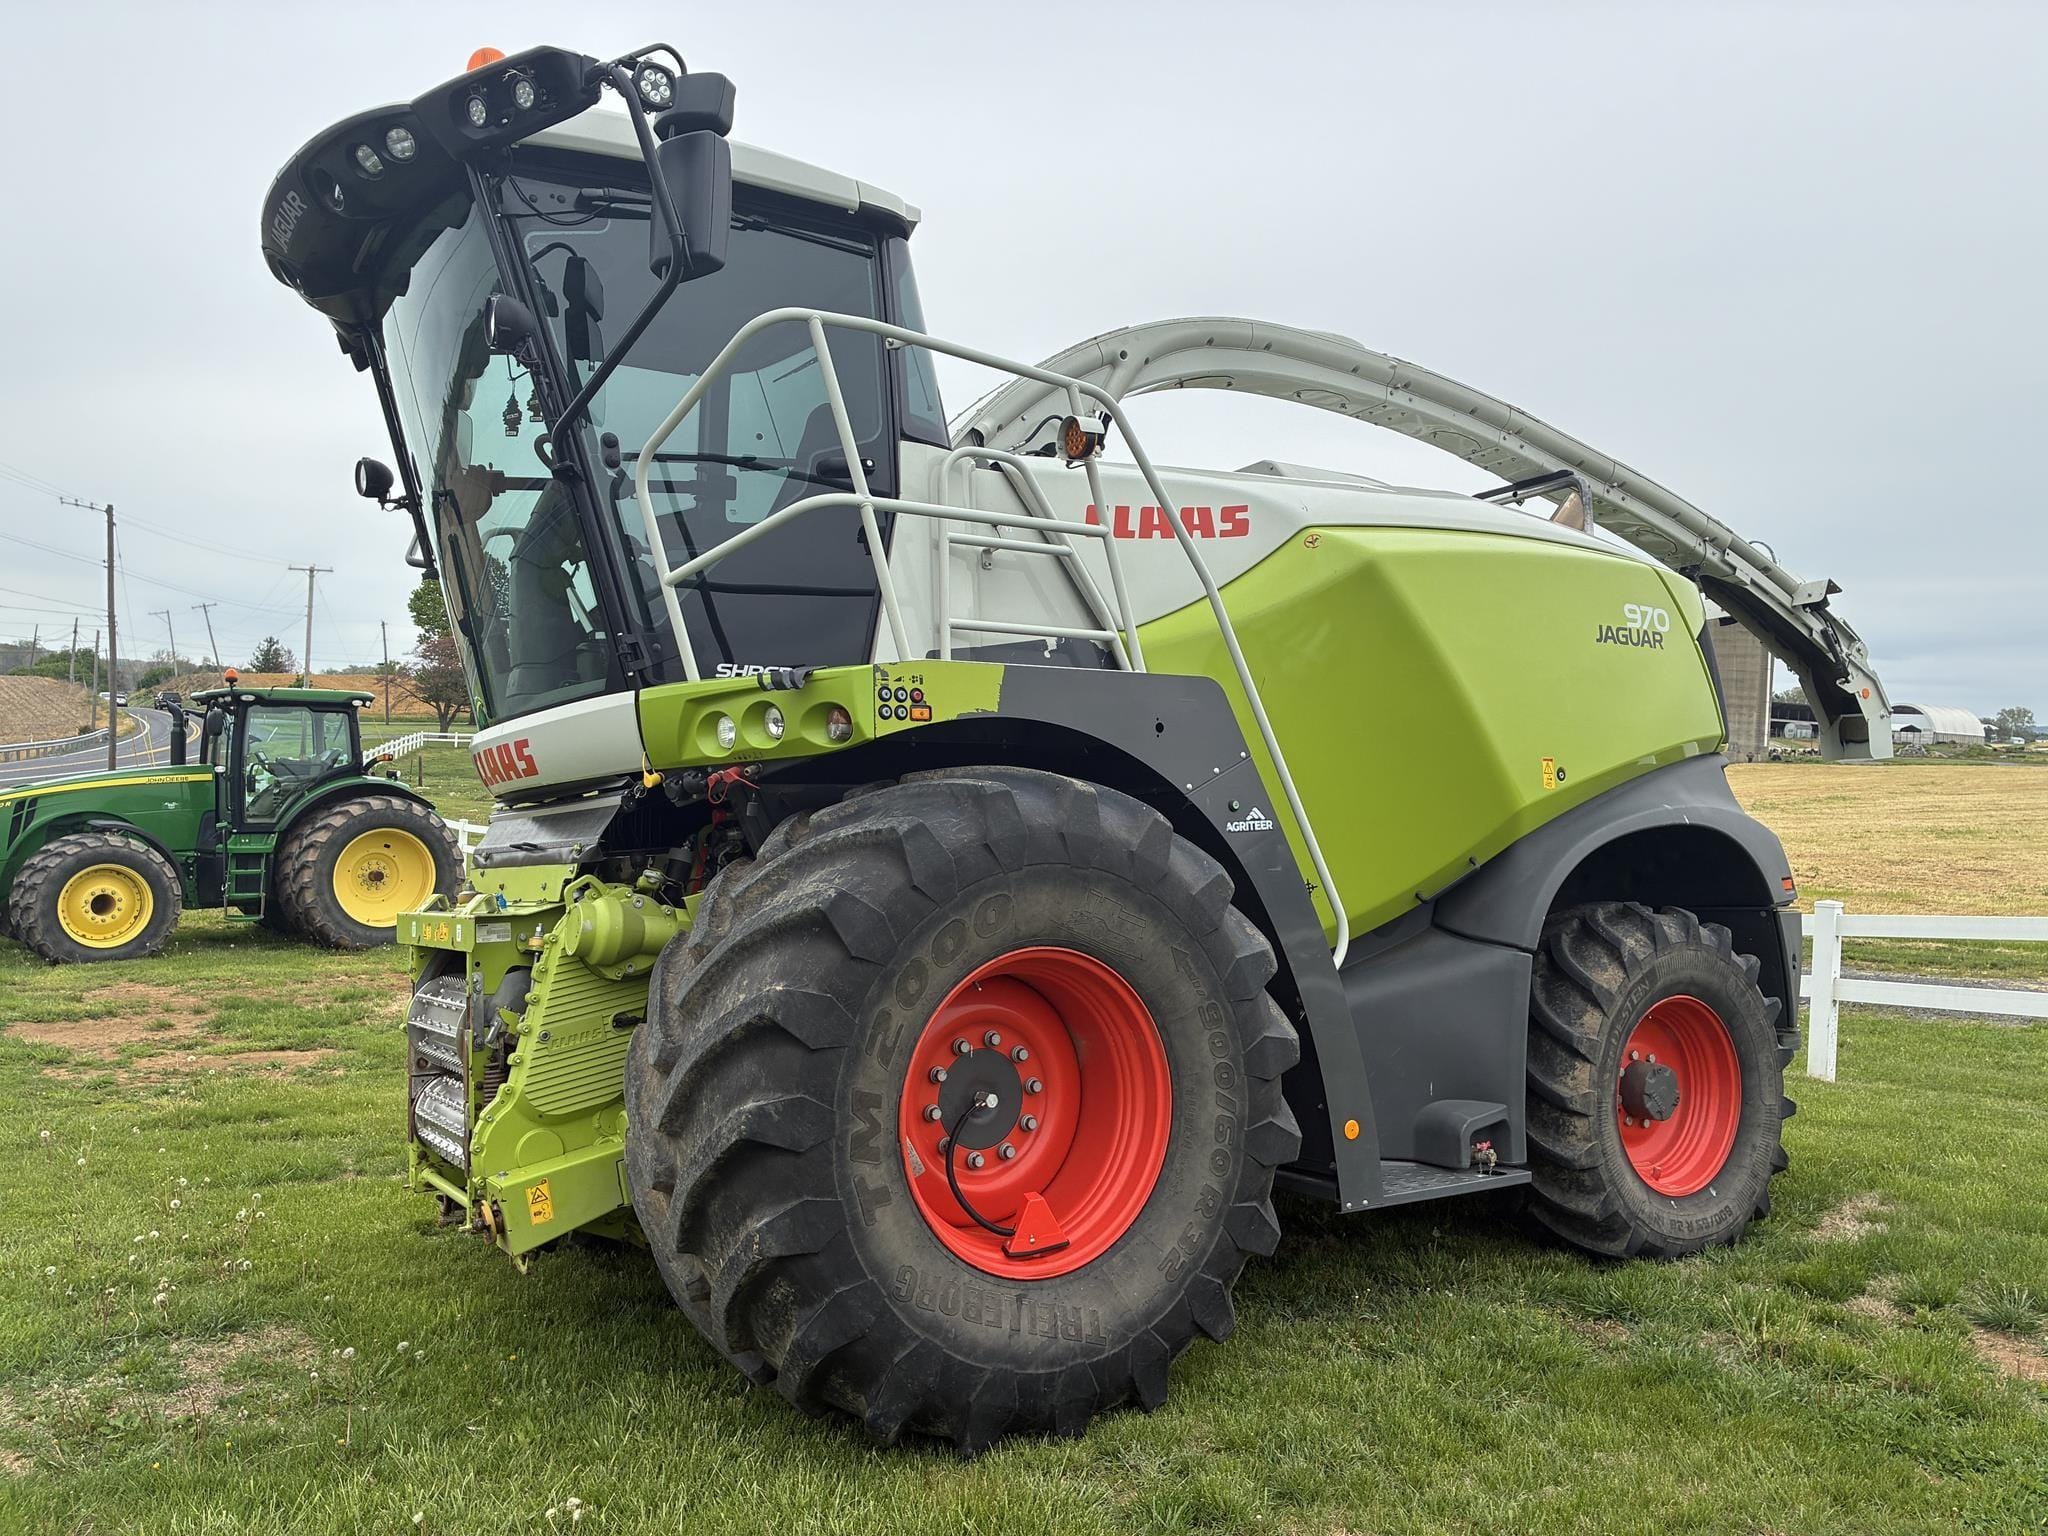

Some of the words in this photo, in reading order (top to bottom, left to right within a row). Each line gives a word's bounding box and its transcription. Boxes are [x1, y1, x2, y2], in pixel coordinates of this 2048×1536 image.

[271, 190, 308, 254] JAGUAR
[1596, 624, 1664, 650] JAGUAR
[1623, 603, 1670, 633] 970
[1226, 820, 1273, 832] AGRITEER
[864, 893, 1015, 1072] 2000
[1197, 1001, 1238, 1178] 900/60
[850, 1089, 893, 1228] TM
[1194, 1182, 1224, 1219] R
[1686, 1219, 1695, 1233] R
[1157, 1221, 1204, 1283] 32
[890, 1264, 1108, 1347] TRELLEBORG
